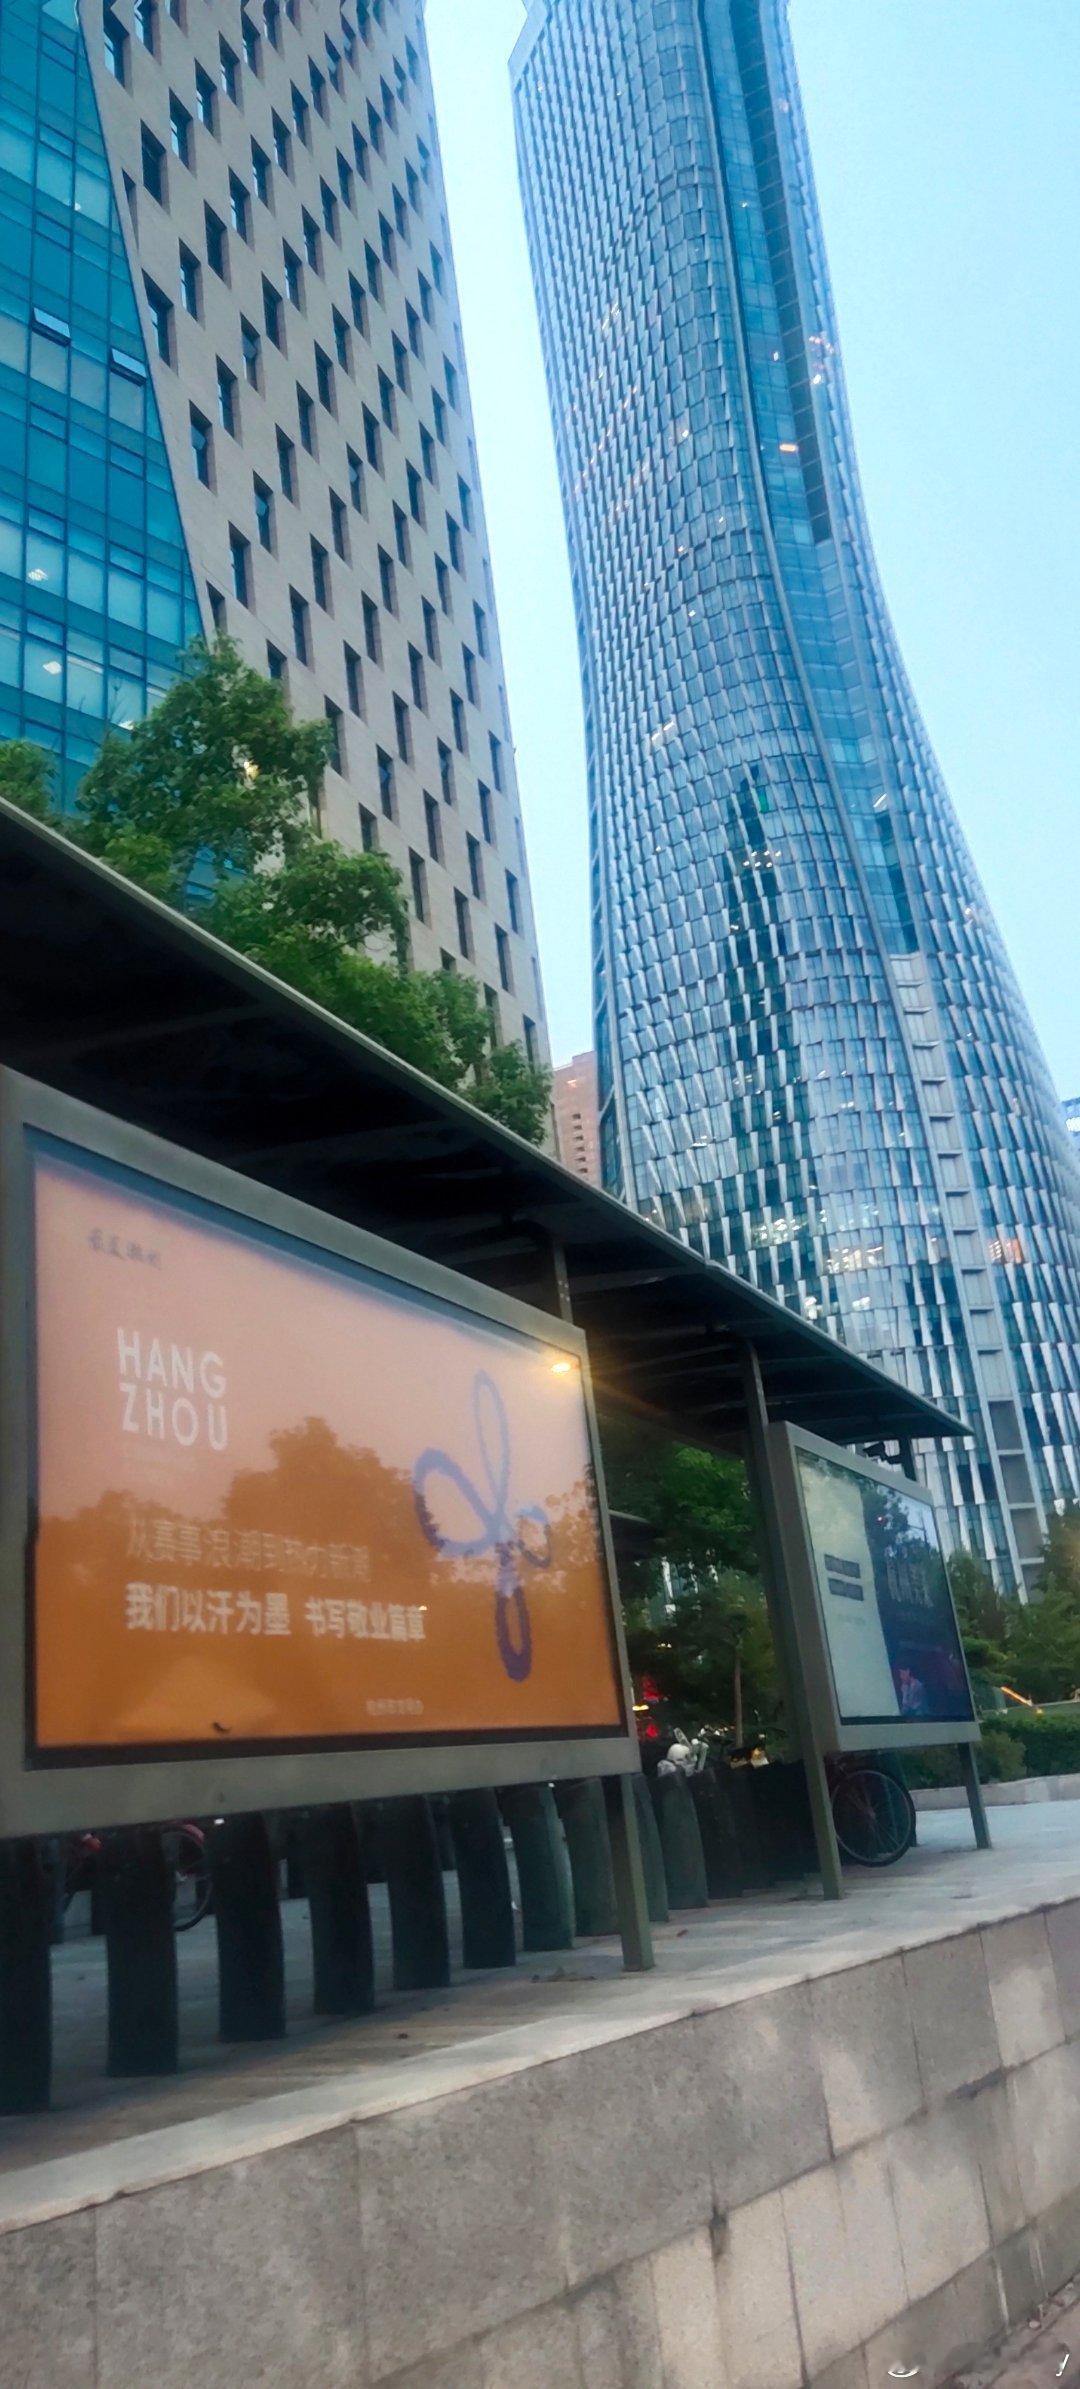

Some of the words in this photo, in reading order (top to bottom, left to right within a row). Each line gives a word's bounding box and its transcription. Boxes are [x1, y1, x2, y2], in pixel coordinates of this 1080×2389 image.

[117, 1327, 227, 1399] HANG
[119, 1382, 229, 1451] ZHOU
[125, 1581, 291, 1637] 我们以汗为墨
[304, 1595, 426, 1643] 书写敬业篇章
